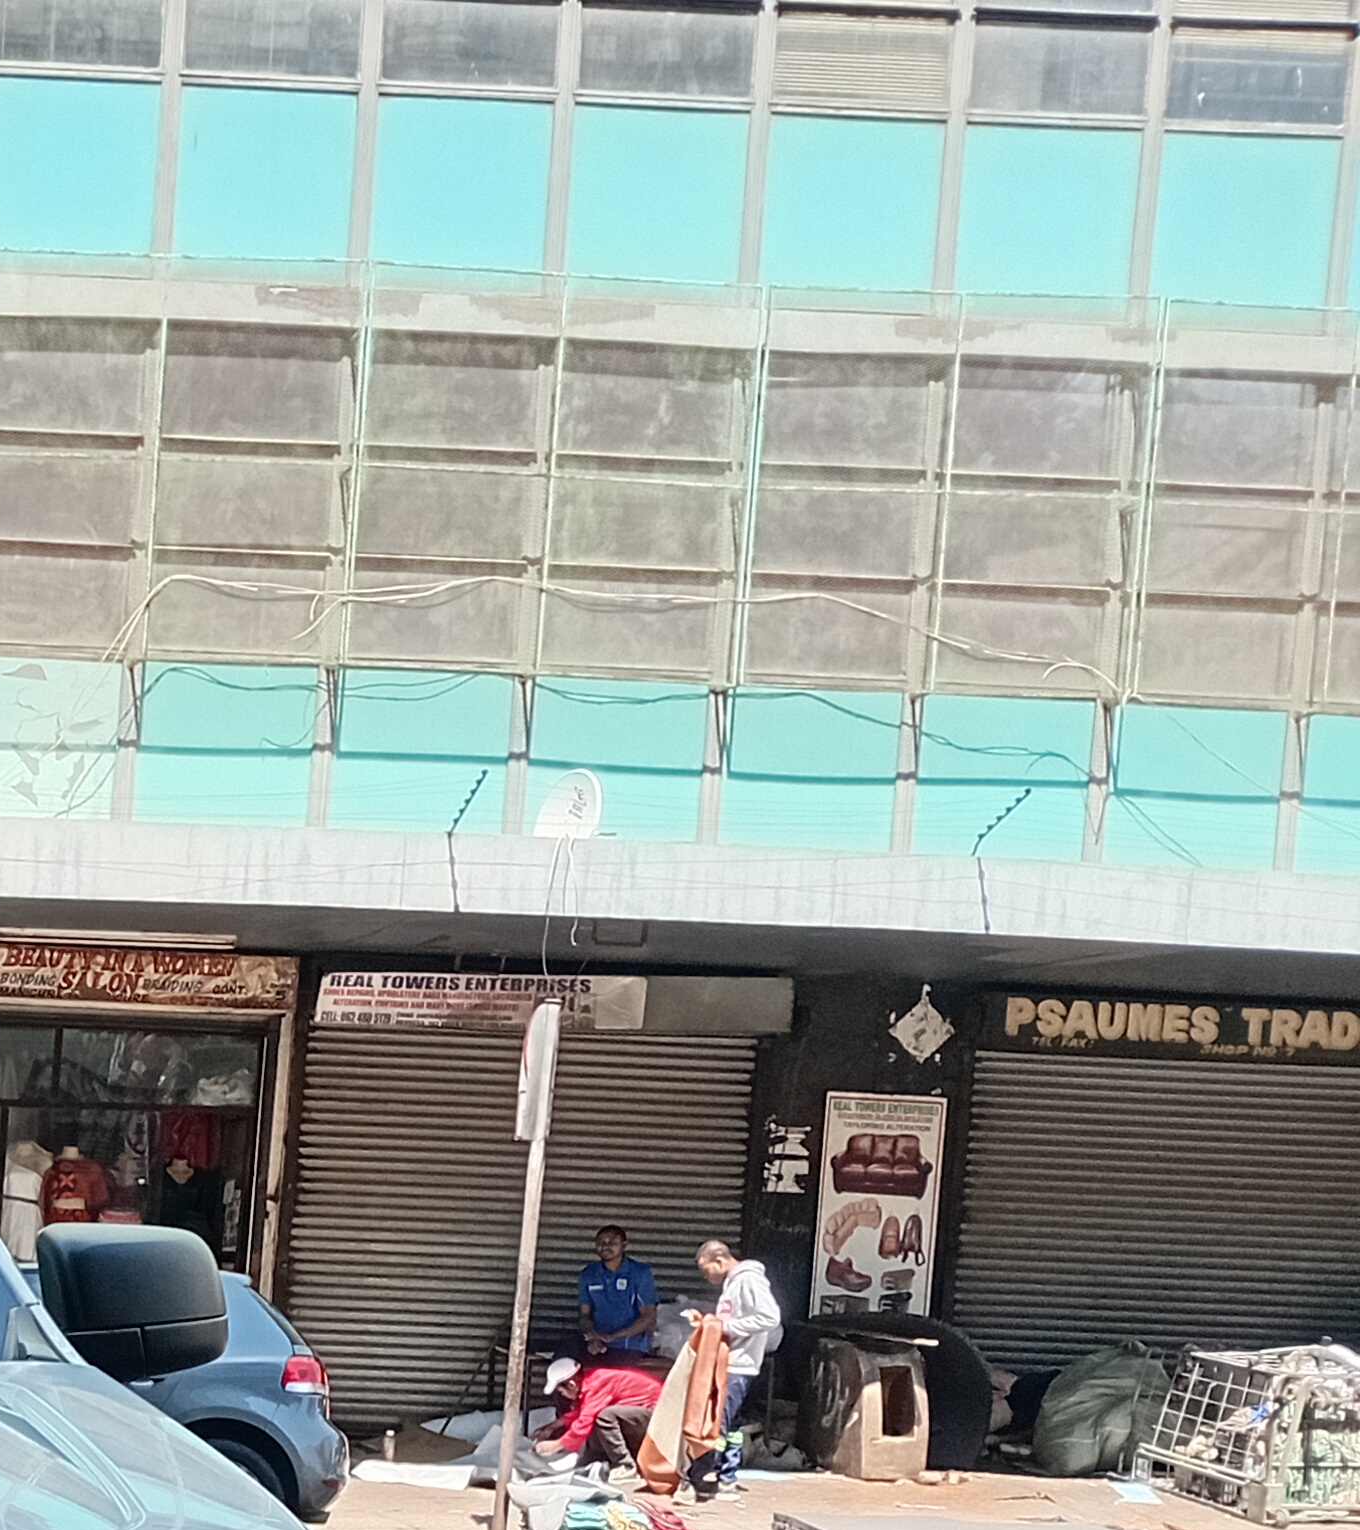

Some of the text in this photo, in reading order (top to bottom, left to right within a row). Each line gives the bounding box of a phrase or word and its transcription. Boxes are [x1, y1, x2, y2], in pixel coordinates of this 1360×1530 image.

[2, 945, 94, 969] BEAUTY
[0, 972, 56, 987] BONDING
[58, 969, 143, 993] SALON
[143, 977, 203, 993] BRAIDING
[329, 974, 592, 993] REAL TOWERS ENTERPRISES
[1005, 996, 1360, 1051] PSAUMES TRAD
